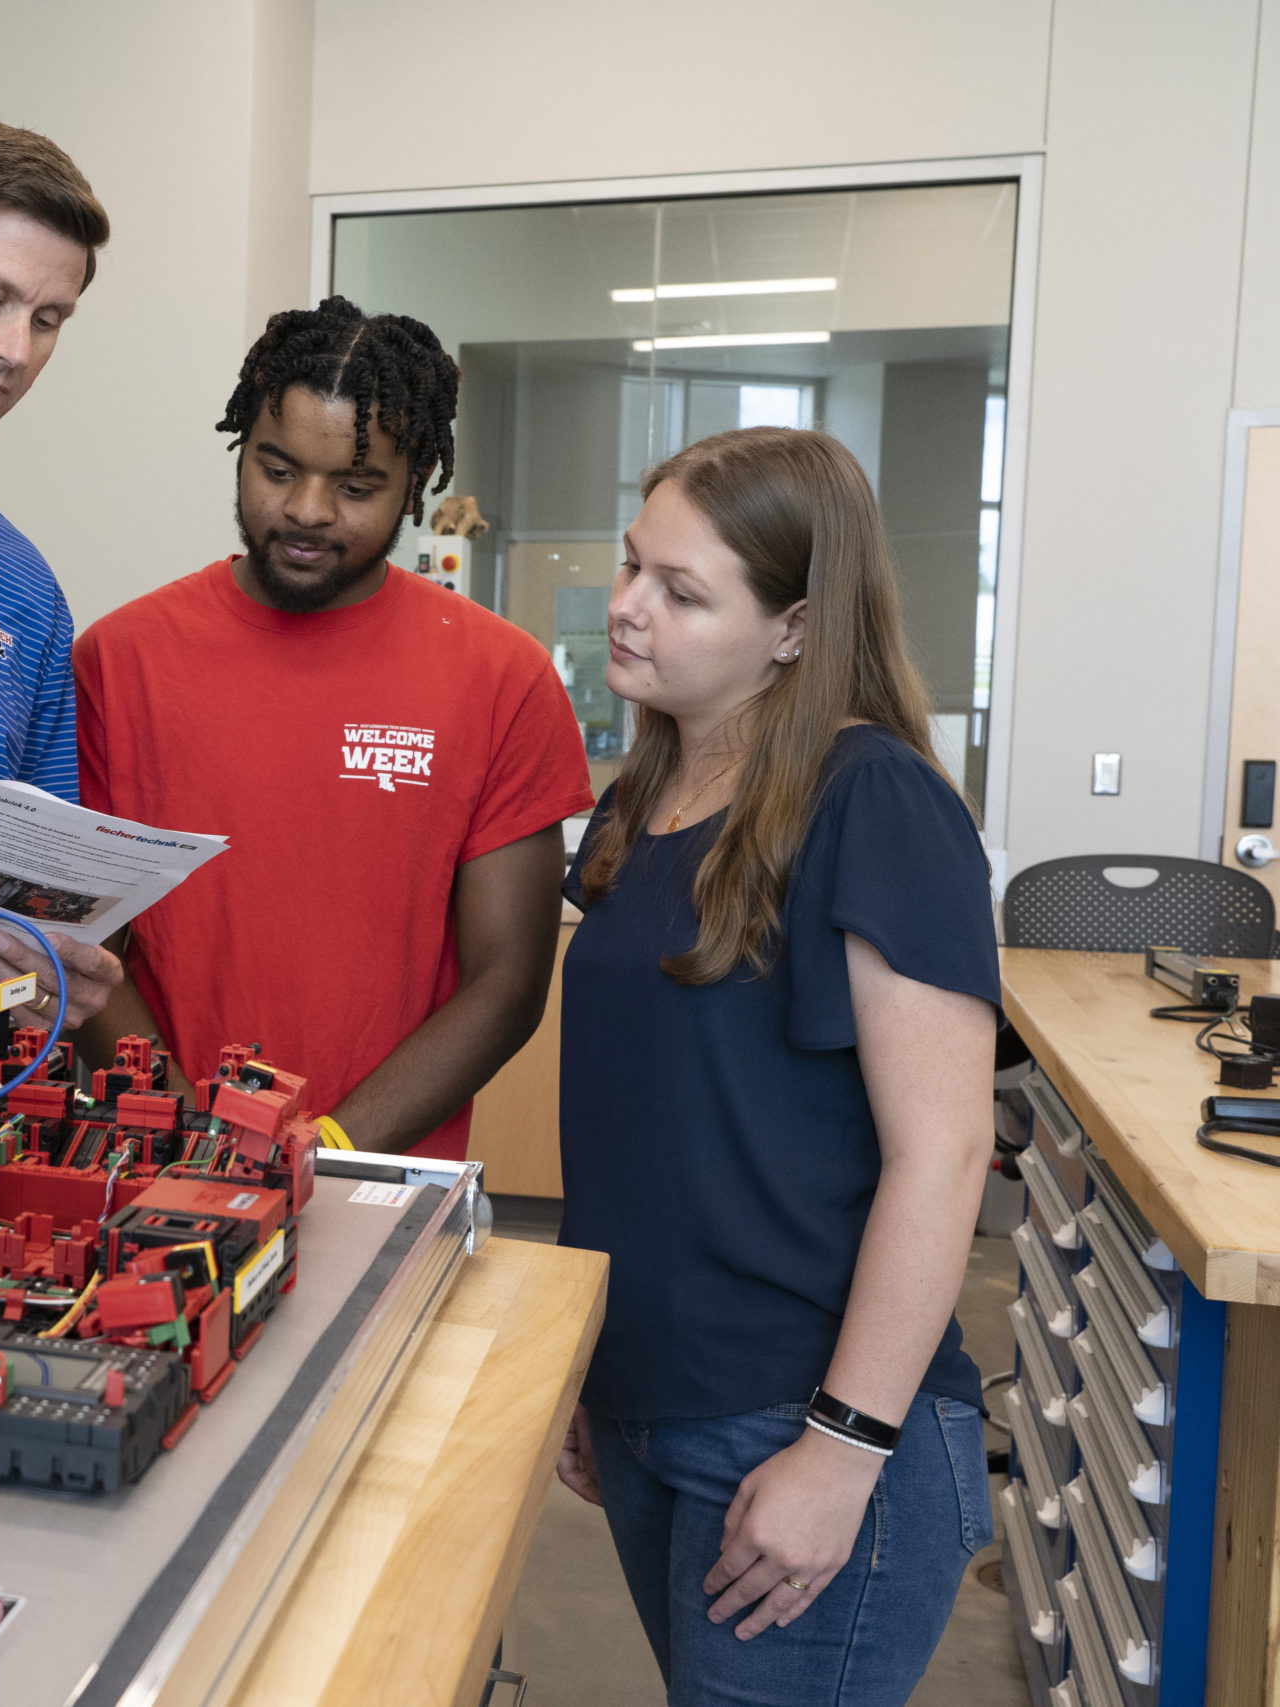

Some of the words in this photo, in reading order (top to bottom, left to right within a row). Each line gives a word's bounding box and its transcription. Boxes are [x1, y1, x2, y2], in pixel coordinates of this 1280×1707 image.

[344, 729, 435, 750] WELCOME
[342, 746, 433, 777] WEEK
[24, 804, 37, 813] 4.0
[95, 825, 179, 848] fischertechnik
